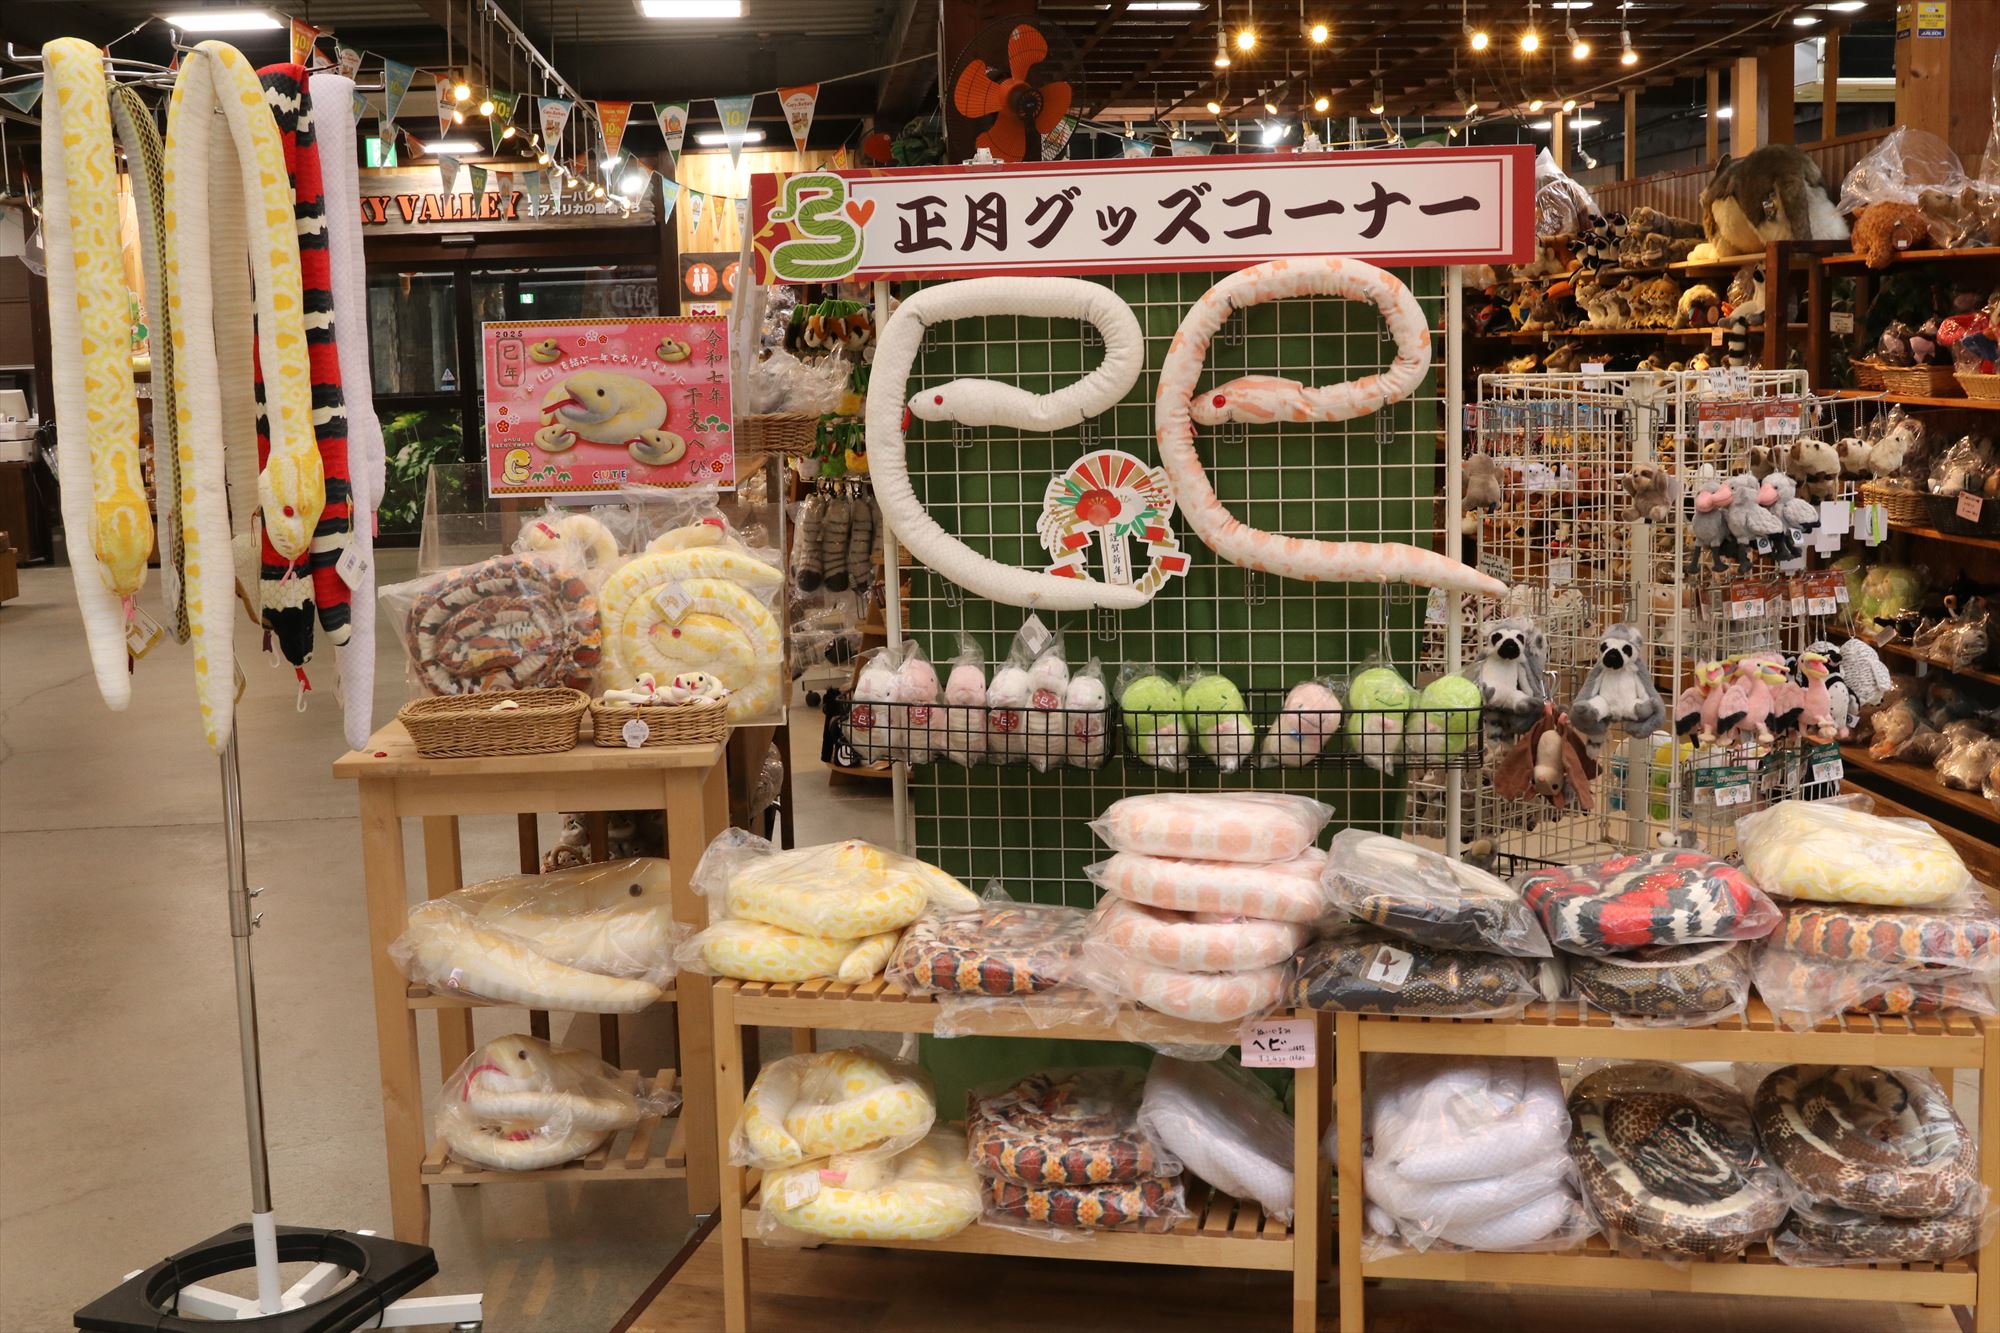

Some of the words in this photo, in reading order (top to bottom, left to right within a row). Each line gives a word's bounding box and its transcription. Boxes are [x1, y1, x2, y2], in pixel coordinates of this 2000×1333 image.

[395, 192, 522, 224] VALLEY
[894, 181, 1480, 254] 正月グッズコーナー
[704, 329, 725, 405] 令和七年
[683, 387, 709, 477] 干支へび
[592, 470, 628, 480] CUTE
